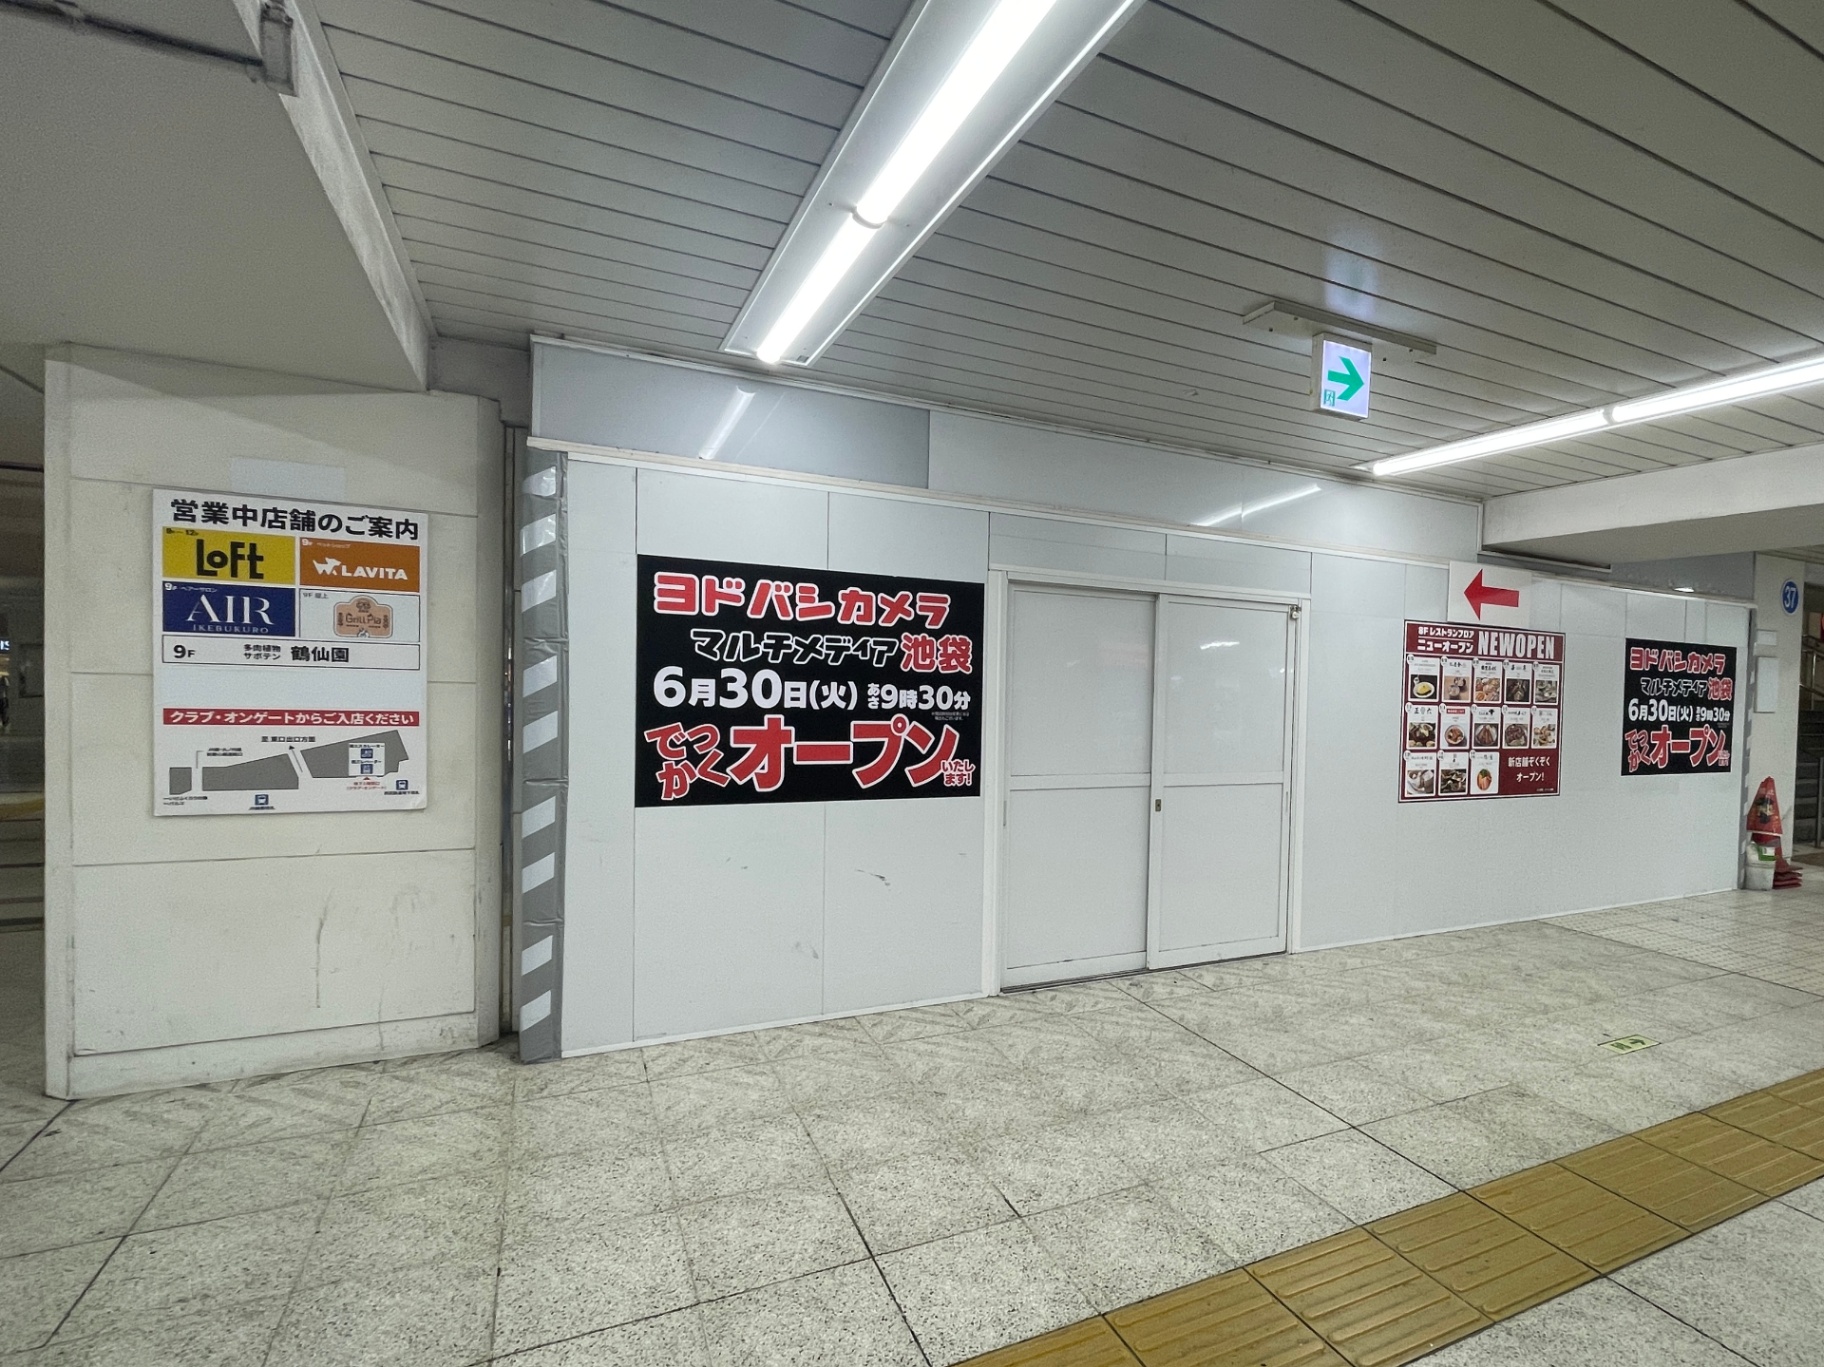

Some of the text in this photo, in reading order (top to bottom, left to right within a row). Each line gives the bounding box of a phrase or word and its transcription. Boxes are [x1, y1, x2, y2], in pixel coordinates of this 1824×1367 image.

[171, 499, 419, 541] 営業中店舗のご案内
[341, 565, 408, 580] LAVITA
[185, 594, 275, 625] AIR
[653, 571, 951, 629] ヨドバシカメラ
[1783, 585, 1797, 609] 37
[193, 624, 269, 634] IKEBUKURO
[173, 644, 196, 659] 9F
[290, 645, 349, 663] 鶴仙園
[690, 628, 974, 674] マルチメディア池袋
[1416, 638, 1474, 654] ニューオープン
[1629, 646, 1726, 675] ヨドバシカメラ
[653, 665, 858, 711] 6月30日(火)
[1640, 676, 1733, 701] マルチメディア池袋
[169, 710, 415, 725] クラブ・オンゲートからご入店ください
[1628, 698, 1694, 723] 6月30日(火)
[726, 713, 960, 792] オープン
[1649, 723, 1726, 769] オープン
